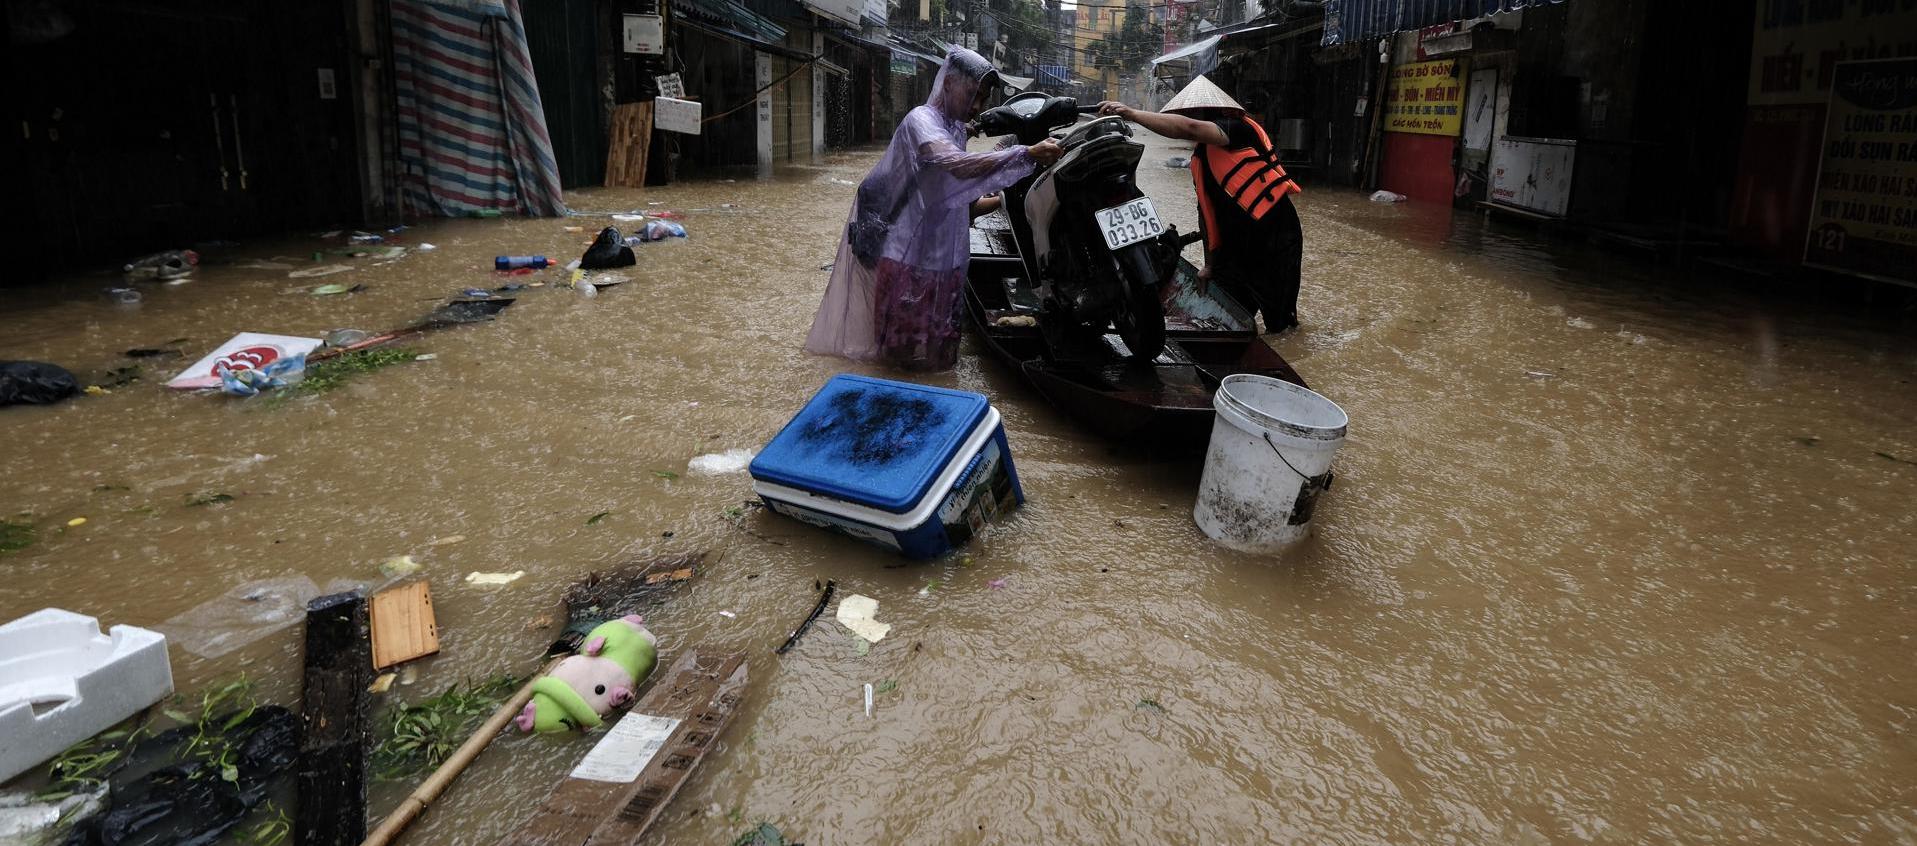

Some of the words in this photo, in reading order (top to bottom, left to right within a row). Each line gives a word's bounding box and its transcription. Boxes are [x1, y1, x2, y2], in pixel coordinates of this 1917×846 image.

[1105, 202, 1148, 227] 29-BG
[1107, 217, 1161, 246] 033.26
[1817, 230, 1845, 253] 121
